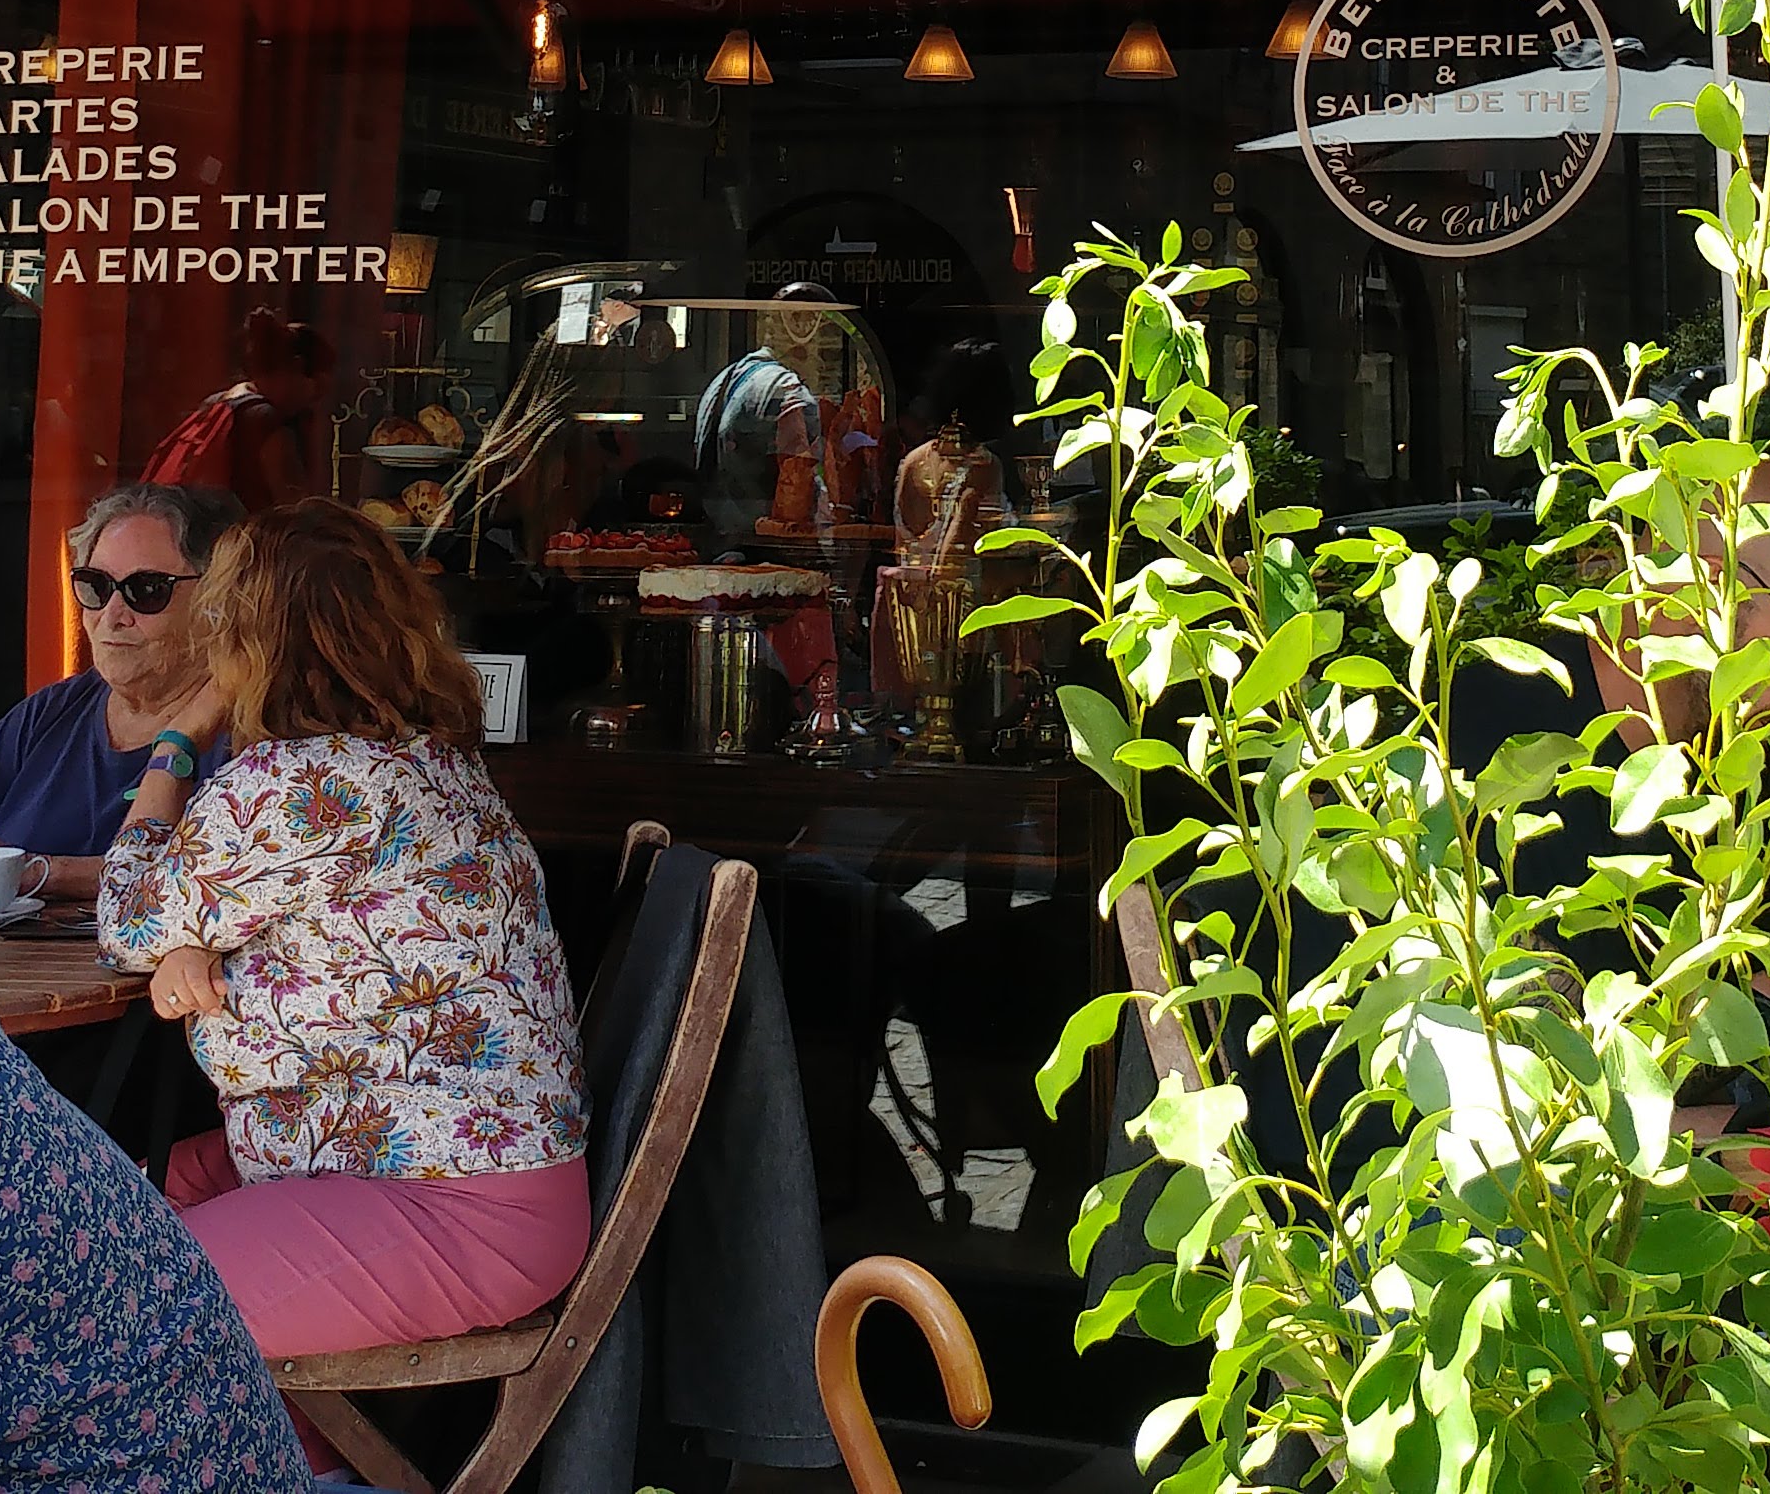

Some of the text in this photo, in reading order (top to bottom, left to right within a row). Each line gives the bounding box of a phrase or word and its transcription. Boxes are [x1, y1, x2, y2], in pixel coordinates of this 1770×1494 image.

[1360, 34, 1539, 60] CREPERIE
[1436, 66, 1456, 85] &
[1316, 90, 1590, 117] SALON DE THE
[1316, 128, 1592, 237] Face à la Cathédrale
[133, 194, 201, 232] DE
[222, 193, 327, 230] THE
[96, 245, 389, 284] EMPORTER
